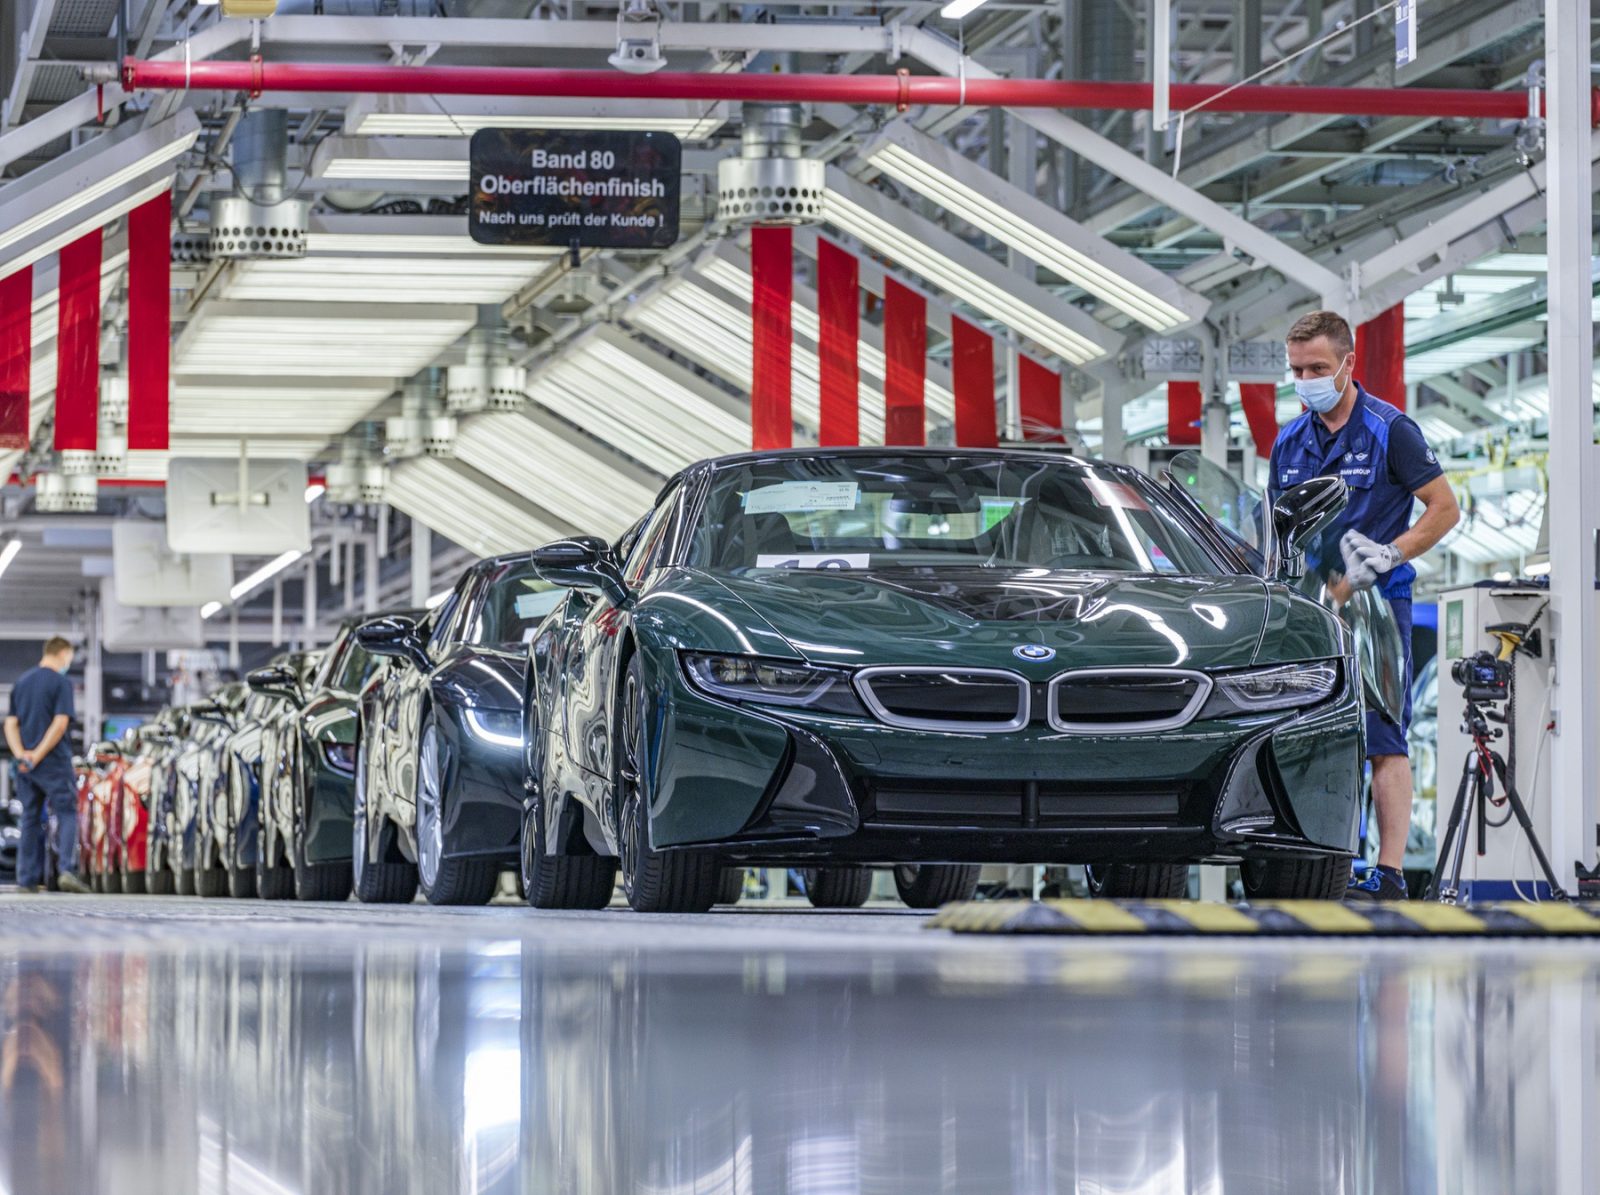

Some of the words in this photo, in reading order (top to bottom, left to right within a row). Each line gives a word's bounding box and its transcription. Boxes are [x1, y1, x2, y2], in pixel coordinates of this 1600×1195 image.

[532, 150, 586, 168] Band
[590, 151, 615, 169] 80
[480, 174, 665, 197] Oberflächenfinish
[479, 211, 516, 225] Nach
[519, 214, 545, 226] uns
[548, 211, 581, 228] prüft
[584, 213, 606, 227] der
[610, 214, 655, 228] Kunde
[658, 215, 664, 228] !
